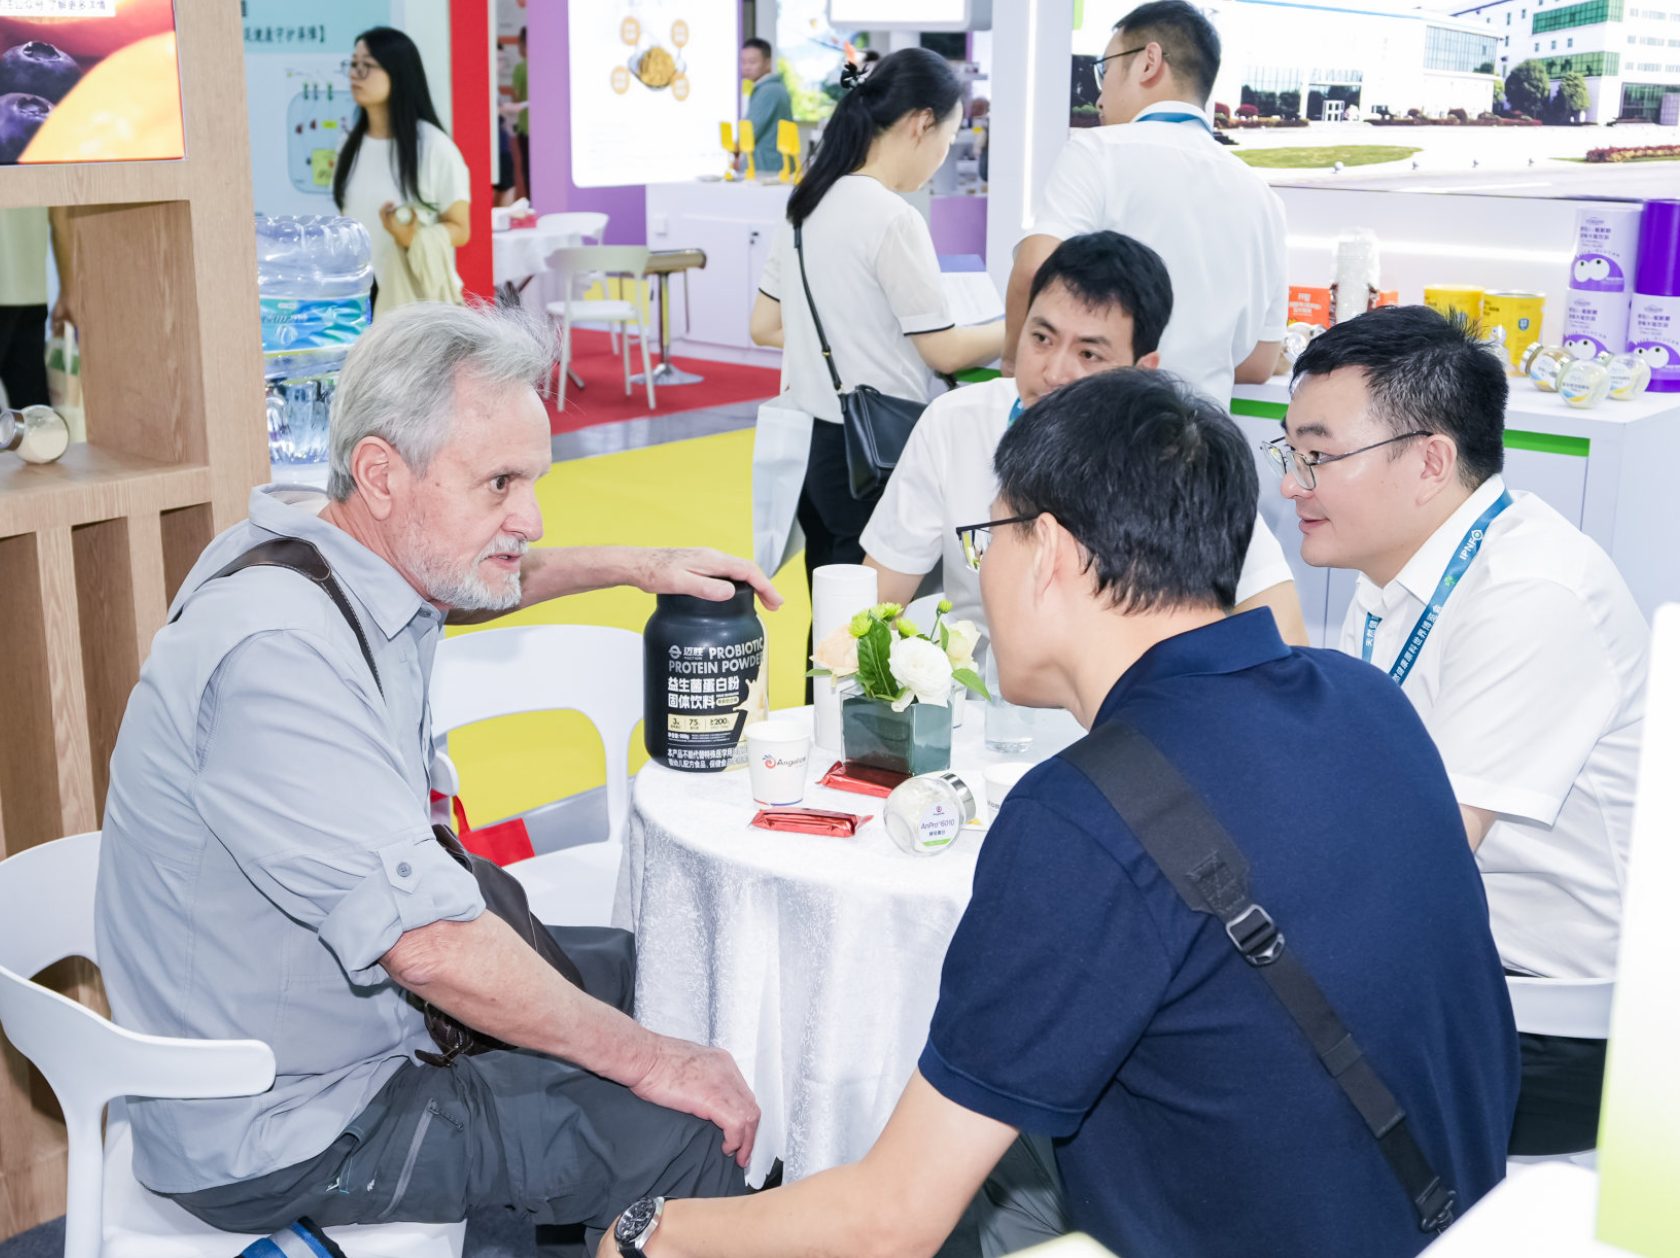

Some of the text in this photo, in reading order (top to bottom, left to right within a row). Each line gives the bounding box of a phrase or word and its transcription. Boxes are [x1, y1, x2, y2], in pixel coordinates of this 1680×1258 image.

[709, 637, 764, 660] PROBIOTIC
[669, 653, 763, 674] PROTEIN POWDE
[668, 675, 740, 693] 益生菌蛋白粉
[668, 693, 715, 709] 固体饮料
